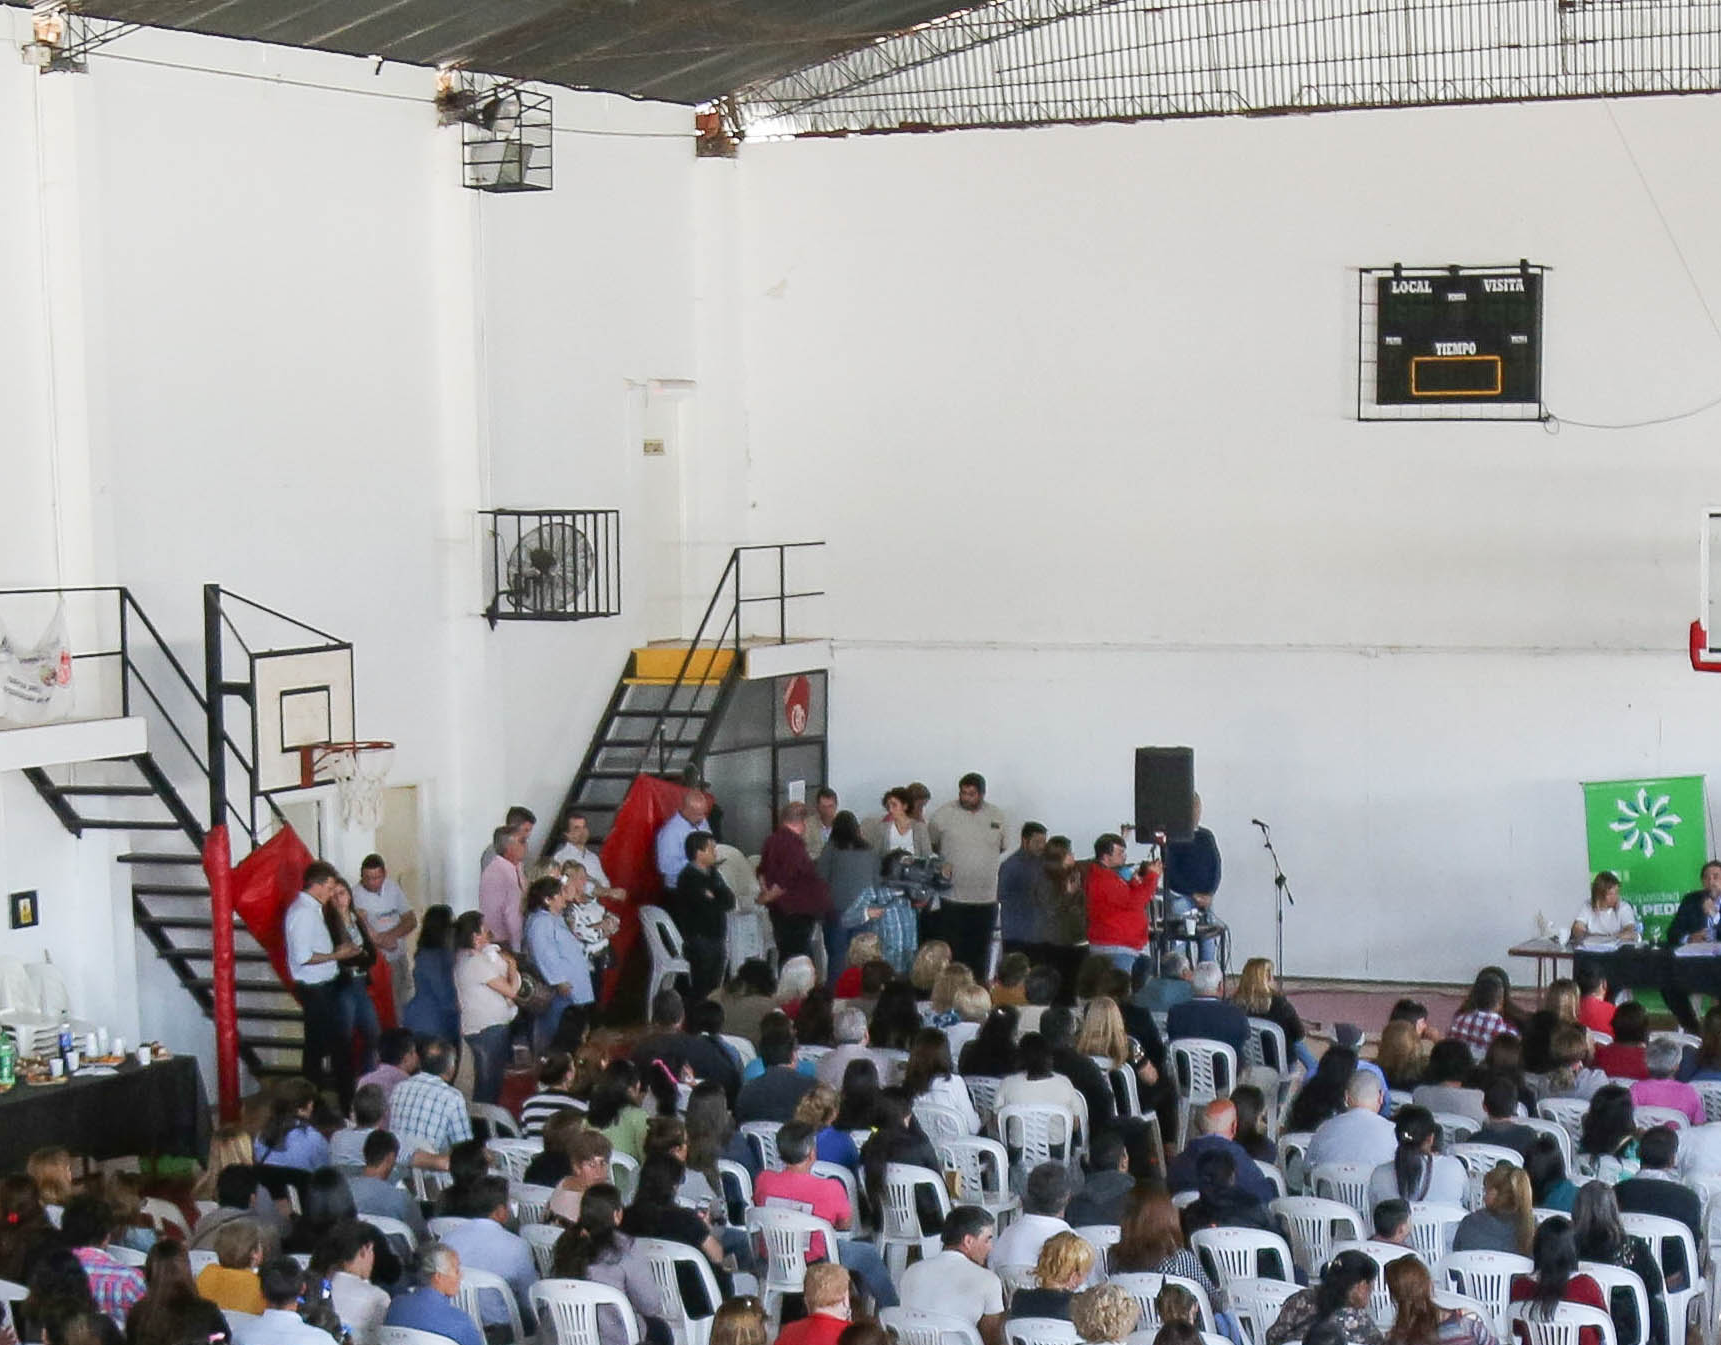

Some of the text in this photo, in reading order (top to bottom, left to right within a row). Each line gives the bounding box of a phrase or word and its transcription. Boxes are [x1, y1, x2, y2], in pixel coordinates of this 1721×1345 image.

[1392, 281, 1432, 294] LOCAL
[1483, 278, 1524, 292] VISITA
[1435, 342, 1477, 355] TIEMPO
